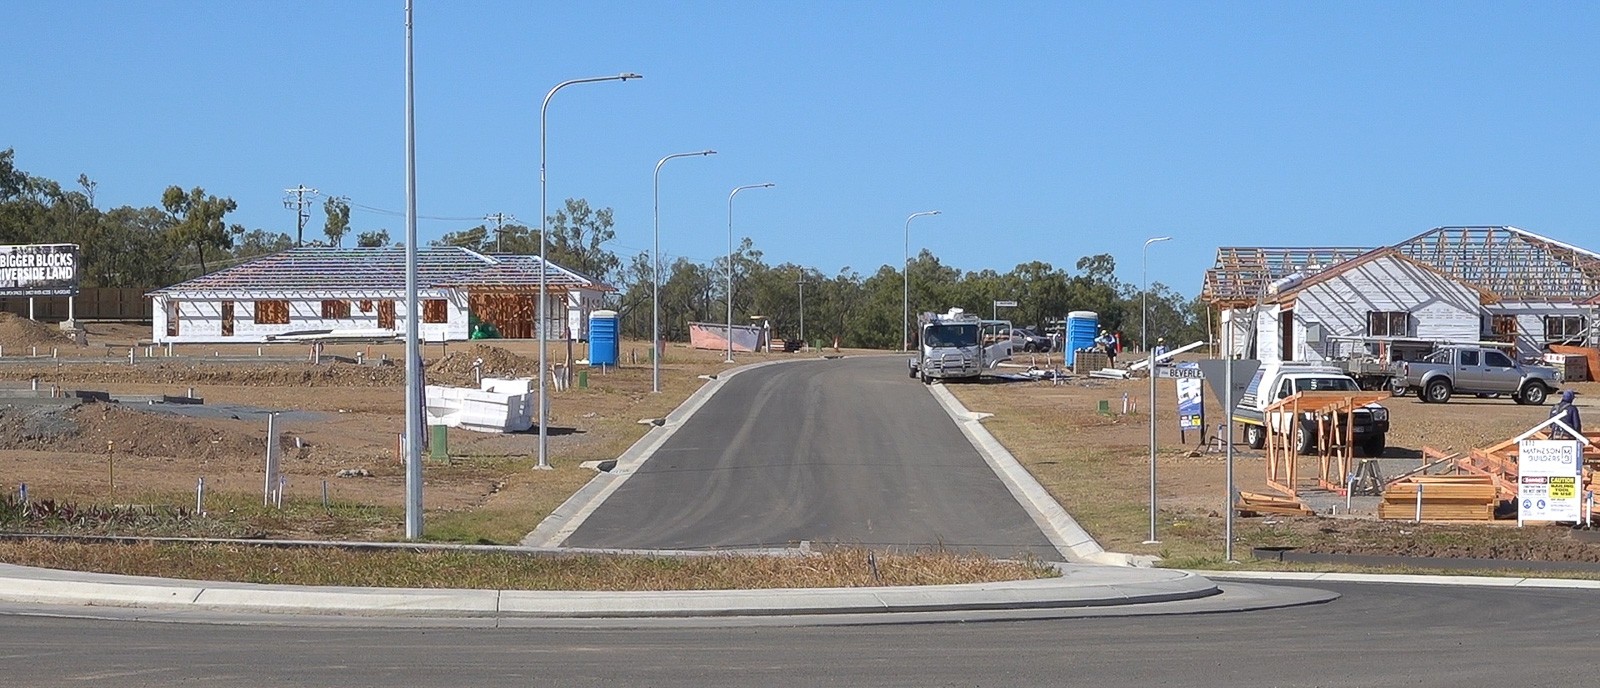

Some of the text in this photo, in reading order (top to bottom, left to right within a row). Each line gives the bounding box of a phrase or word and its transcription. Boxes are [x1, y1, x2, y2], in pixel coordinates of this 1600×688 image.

[0, 253, 73, 267] BIGGER BLOCKS
[0, 266, 73, 280] IVERSIDE LAND
[1170, 368, 1205, 378] BEVERLE
[1523, 447, 1561, 455] MATHESON
